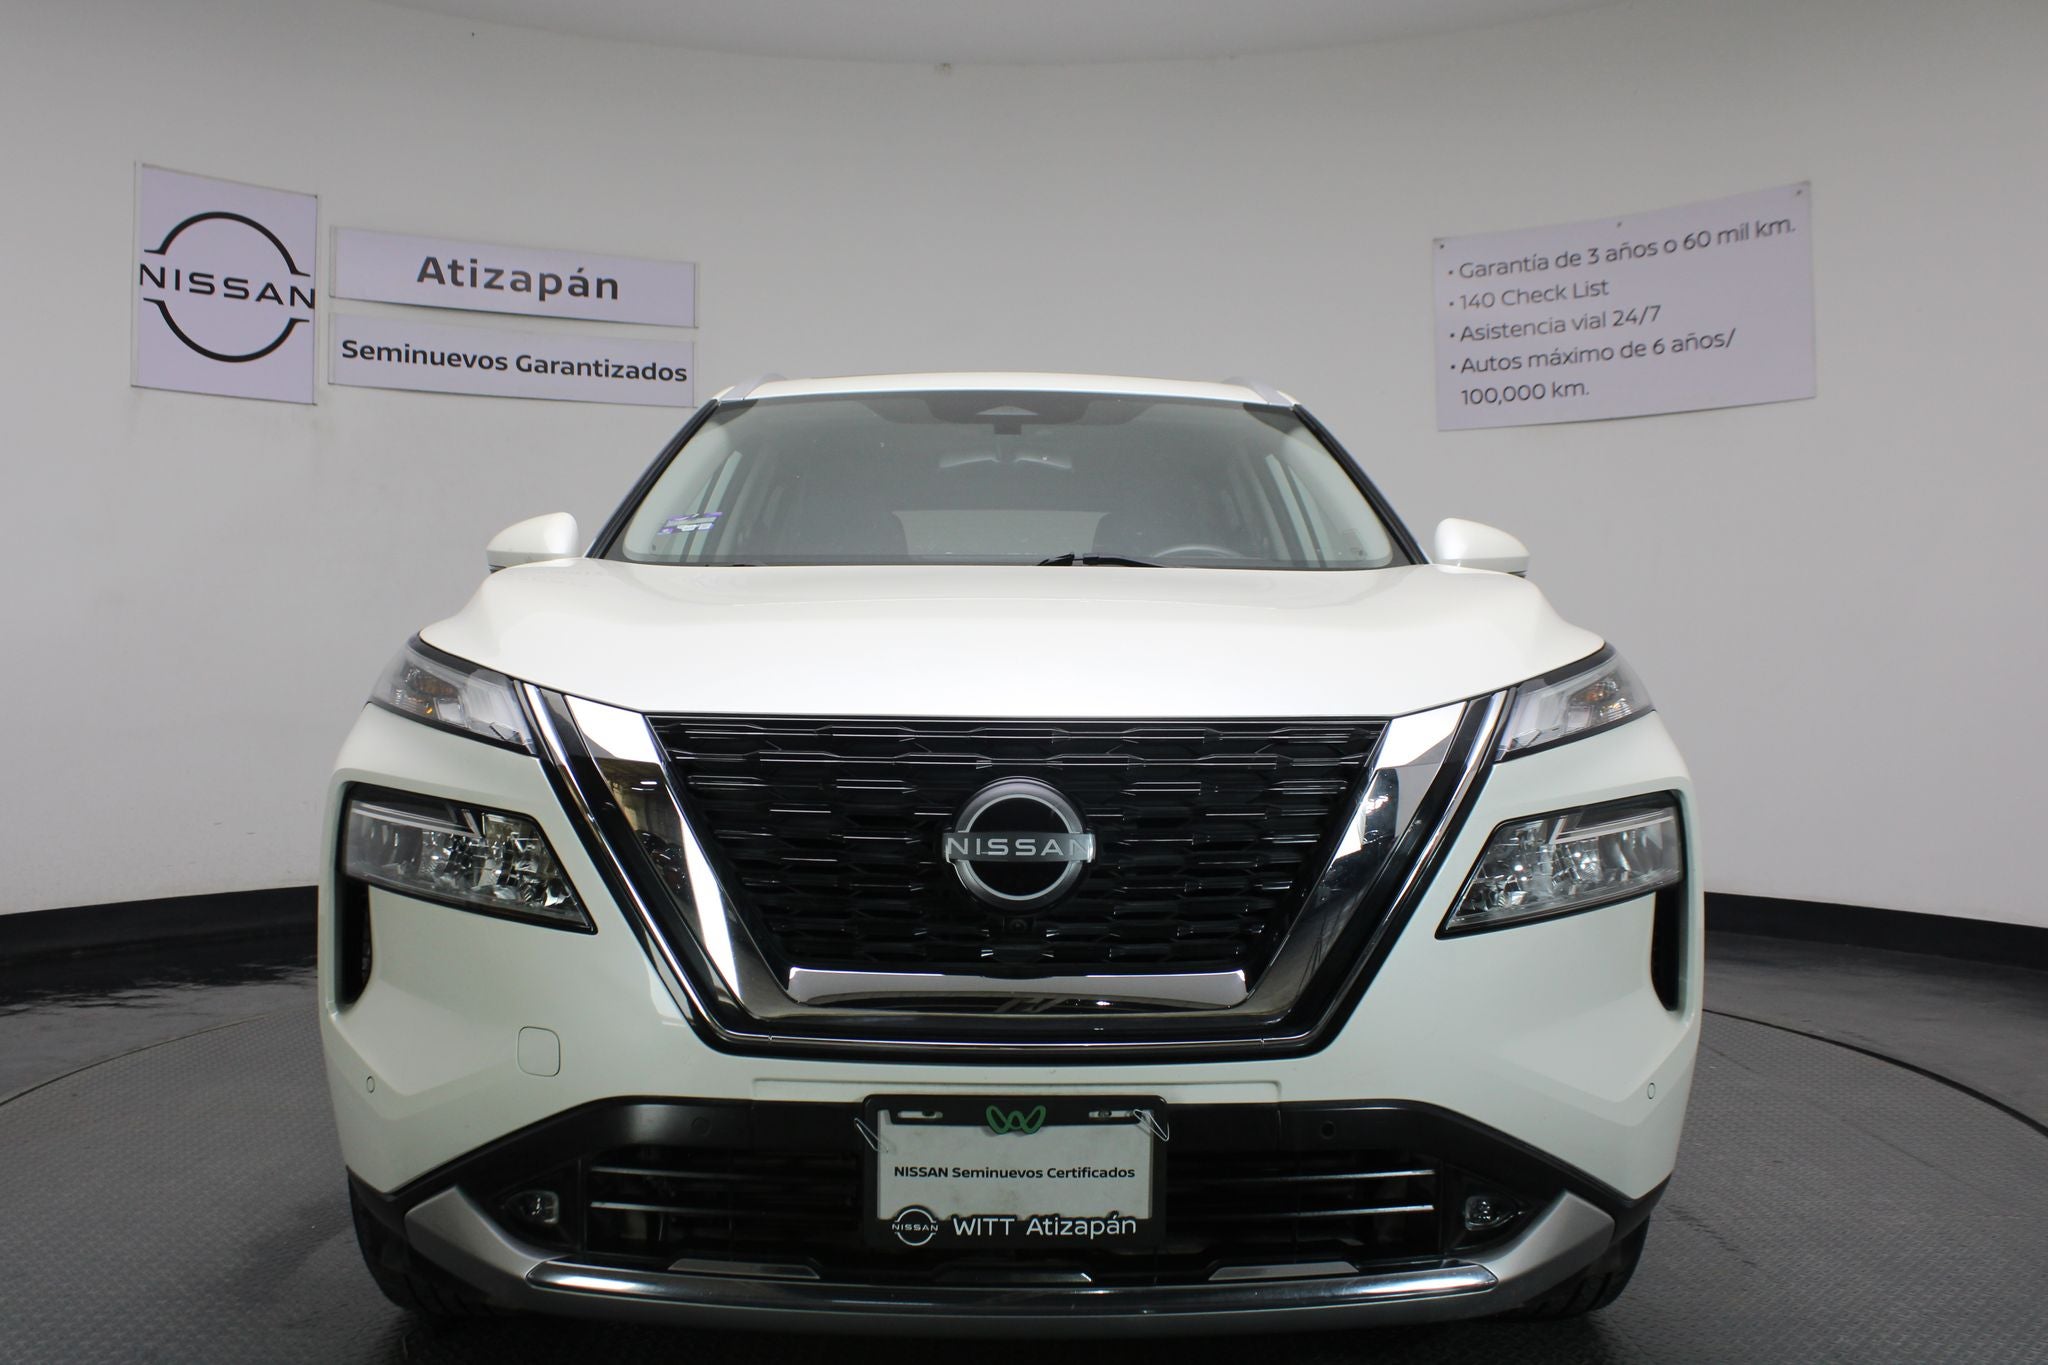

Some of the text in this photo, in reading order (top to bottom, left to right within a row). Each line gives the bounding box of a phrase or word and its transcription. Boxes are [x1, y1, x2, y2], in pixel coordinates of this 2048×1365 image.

[1459, 216, 1797, 280] Garantía de 3 años o 60 mil km.
[139, 261, 315, 310] NISSAN
[416, 256, 619, 302] Atizapán
[1460, 278, 1610, 310] 140 Check List
[1460, 304, 1661, 343] Asistencia vial 24/7
[341, 339, 688, 382] Seminuevos Garantizados
[1461, 353, 1523, 375] Autos
[1528, 345, 1614, 369] máximo
[1620, 339, 1647, 360] de
[1653, 335, 1665, 356] 6
[1461, 379, 1591, 408] 100,000 km.
[947, 837, 1093, 856] NISSAN
[894, 1166, 1136, 1180] NISSAN Seminuevos Certificados
[891, 1222, 939, 1233] NISSAN
[952, 1213, 1137, 1240] WITT Atizapán
